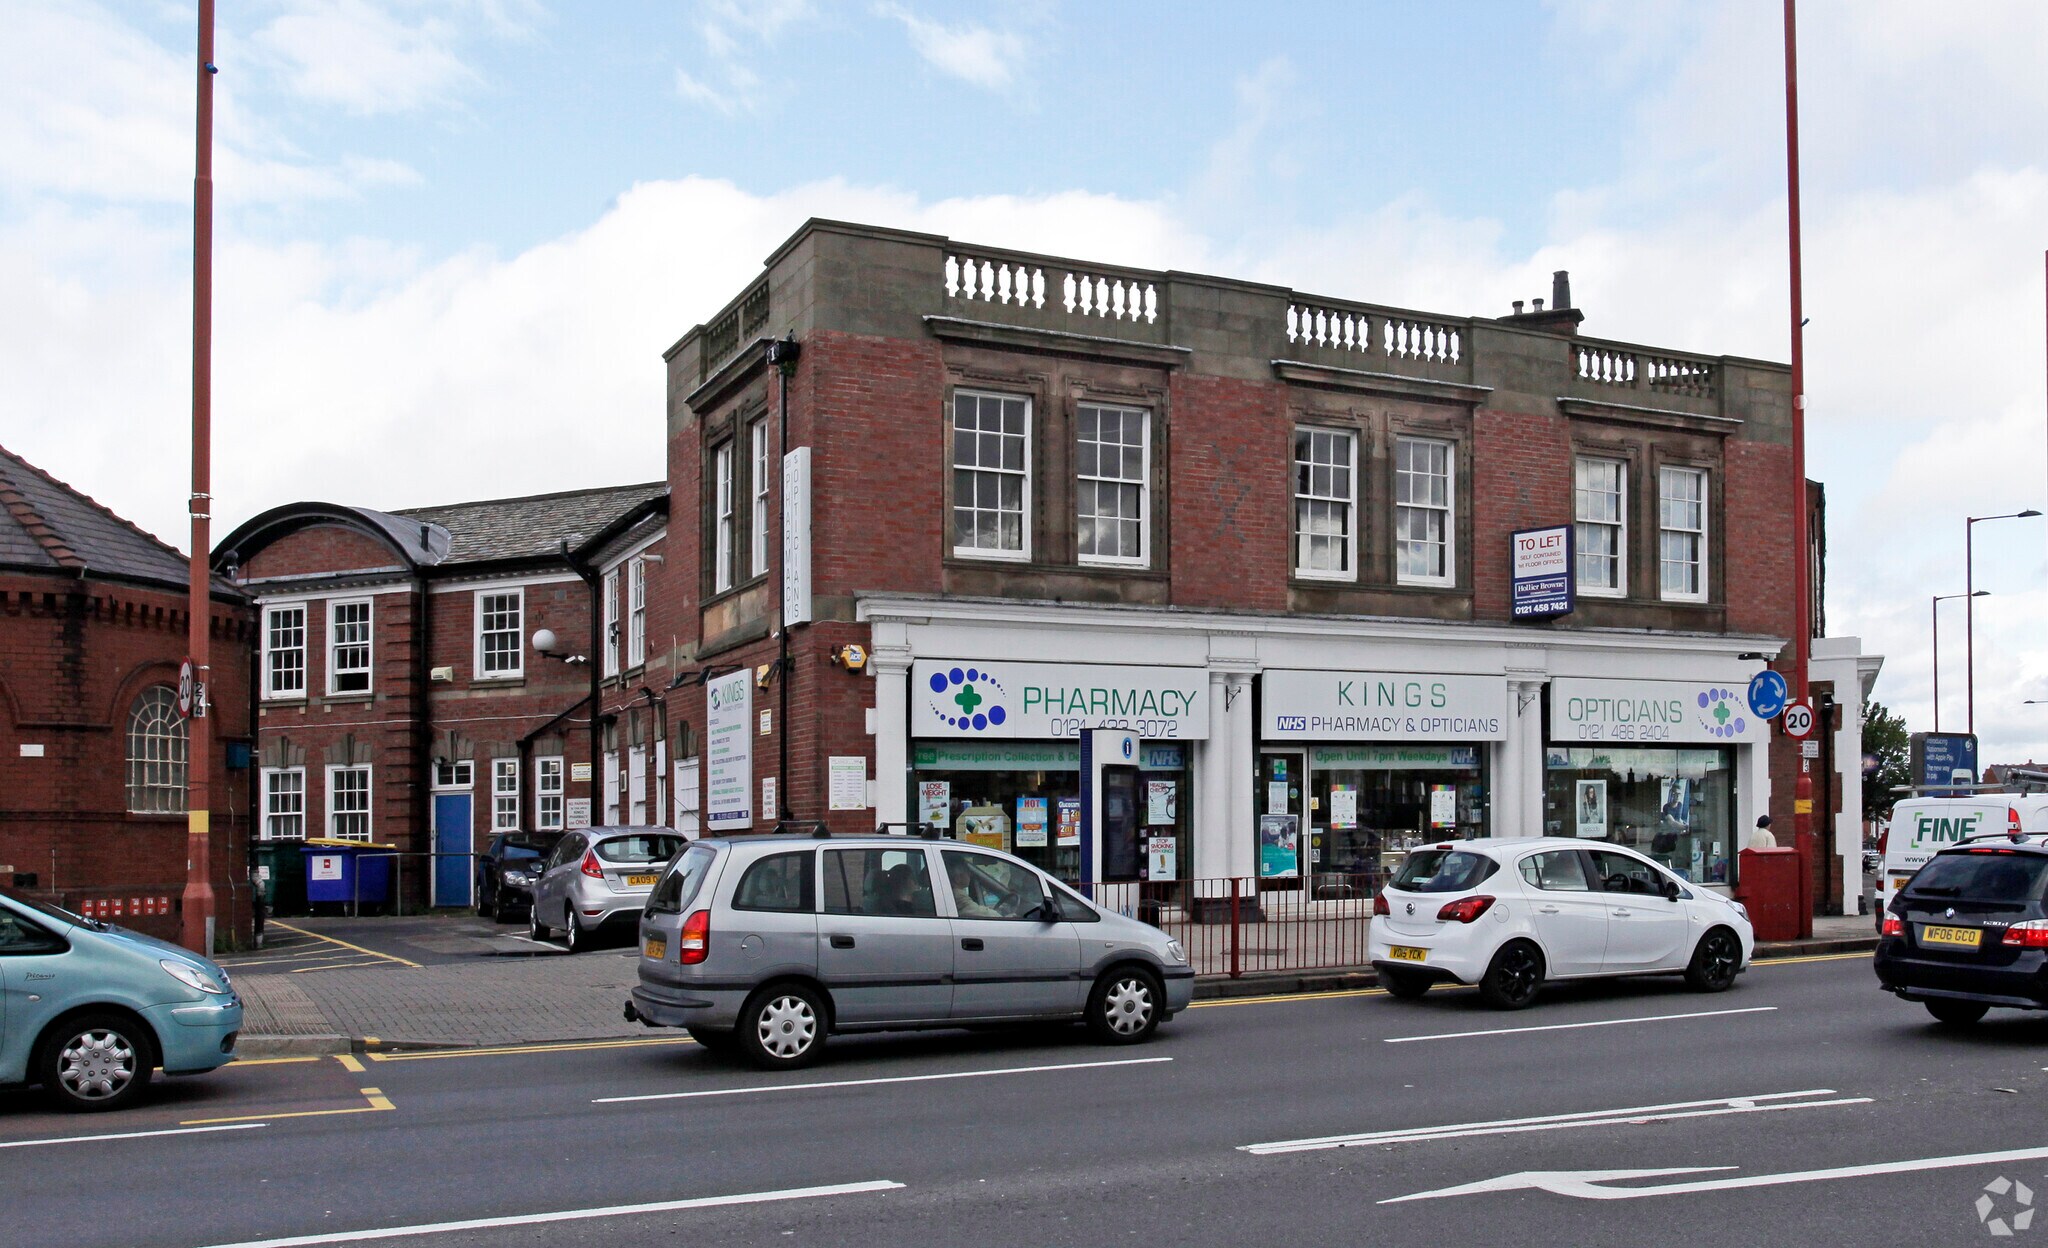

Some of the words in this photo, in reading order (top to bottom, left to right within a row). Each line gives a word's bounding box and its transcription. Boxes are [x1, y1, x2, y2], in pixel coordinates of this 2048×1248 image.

[1519, 538, 1535, 551] TO
[1540, 535, 1562, 549] LET
[1533, 551, 1561, 559] CONTAINED
[1540, 581, 1564, 589] Browne
[1515, 605, 1532, 614] 0121
[1533, 603, 1549, 613] 458
[1550, 601, 1567, 611] 7421
[181, 674, 190, 699] 20
[722, 680, 745, 705] KINGS
[1338, 681, 1446, 708] KINGS
[1023, 686, 1198, 717] PHARMACY
[1568, 697, 1683, 723] OPTICIANS
[1051, 719, 1086, 737] 0121
[1136, 719, 1178, 738] 3072
[1278, 716, 1306, 731] NHS
[1311, 716, 1400, 732] PHARMACY
[1405, 717, 1416, 732] &
[1420, 717, 1499, 733] OPTICIANS
[1787, 712, 1810, 729] 20
[1579, 724, 1604, 740] 0121
[1611, 724, 1635, 740] 486
[1640, 725, 1669, 740] 2404
[937, 751, 1001, 763] Prescription
[1004, 751, 1055, 762] Collection
[1057, 751, 1065, 762] &
[1151, 750, 1183, 767] NHS
[1315, 750, 1343, 763] Open
[1346, 750, 1370, 761] Until
[1374, 750, 1395, 763] 7pm
[1398, 750, 1448, 763] Weekdays
[1451, 749, 1477, 765] NHS
[1946, 754, 1954, 762] Pay
[921, 789, 947, 797] WEIGHT
[1024, 799, 1040, 808] HOT
[1916, 818, 1977, 842] FINE
[630, 875, 651, 885] CA09
[1927, 927, 1952, 940] WF06
[1954, 929, 1976, 943] GCO
[1408, 948, 1423, 960] YCK
